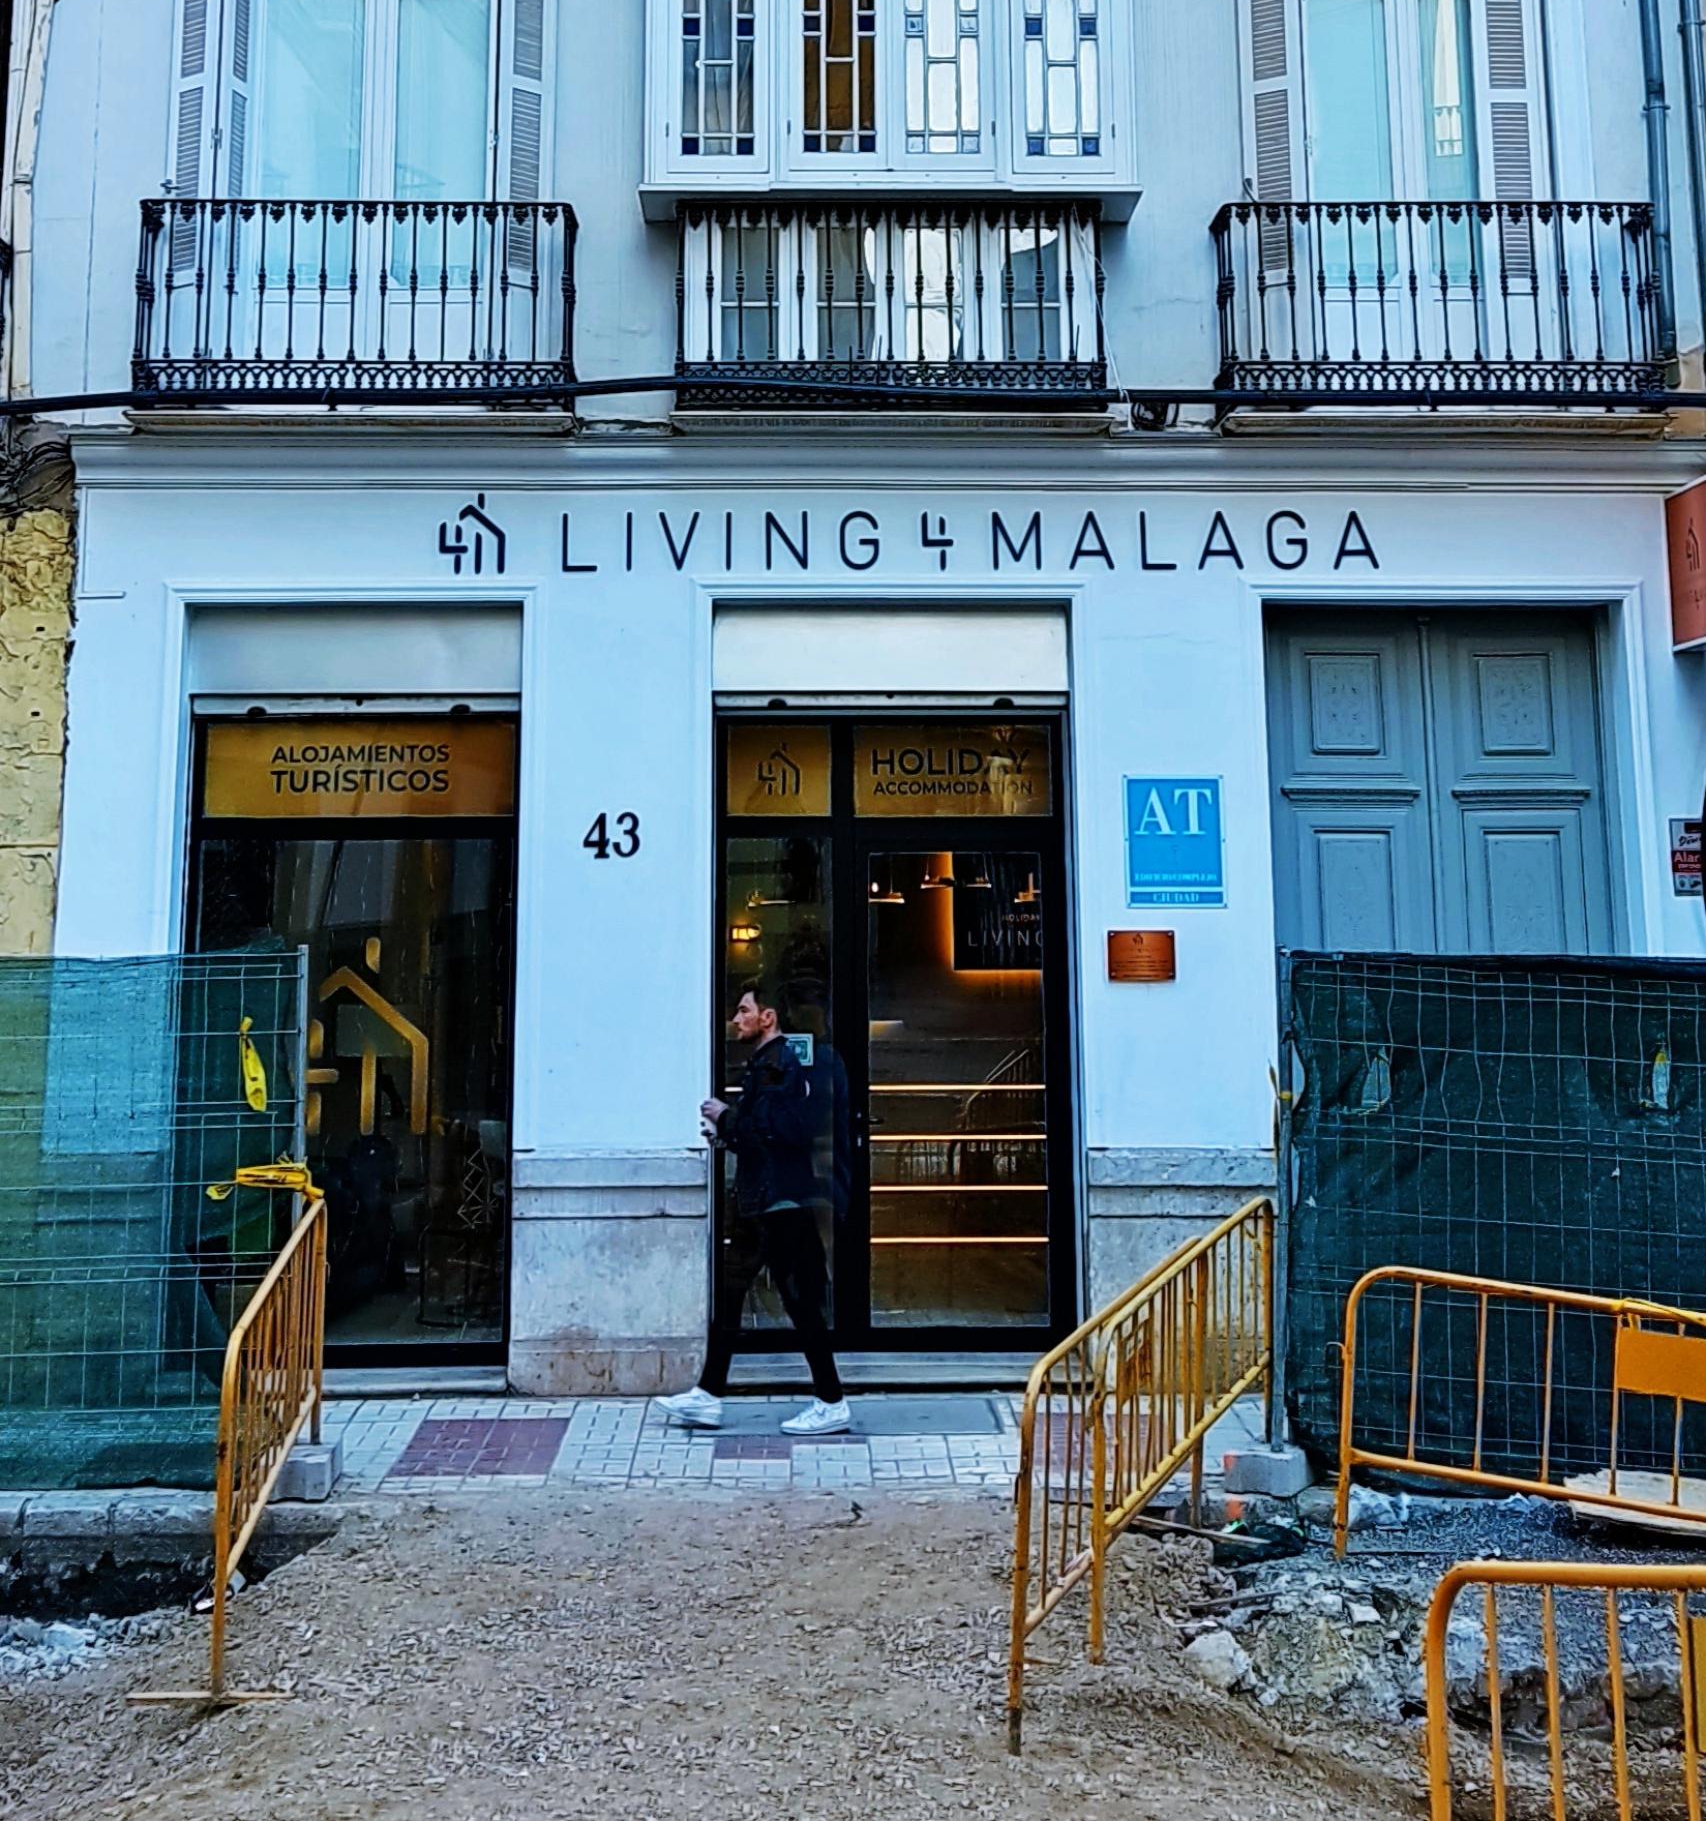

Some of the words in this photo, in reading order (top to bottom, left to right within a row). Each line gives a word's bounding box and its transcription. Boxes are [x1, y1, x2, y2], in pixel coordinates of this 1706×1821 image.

[561, 510, 881, 572] LIVING
[921, 510, 954, 572] 4
[991, 510, 1380, 571] MALAGA
[270, 744, 451, 764] ALOJAMIENTOS
[270, 764, 450, 794] TURÍSTICOS
[1134, 786, 1213, 836] AT
[582, 811, 641, 860] 43
[1152, 892, 1199, 903] CIUDAD
